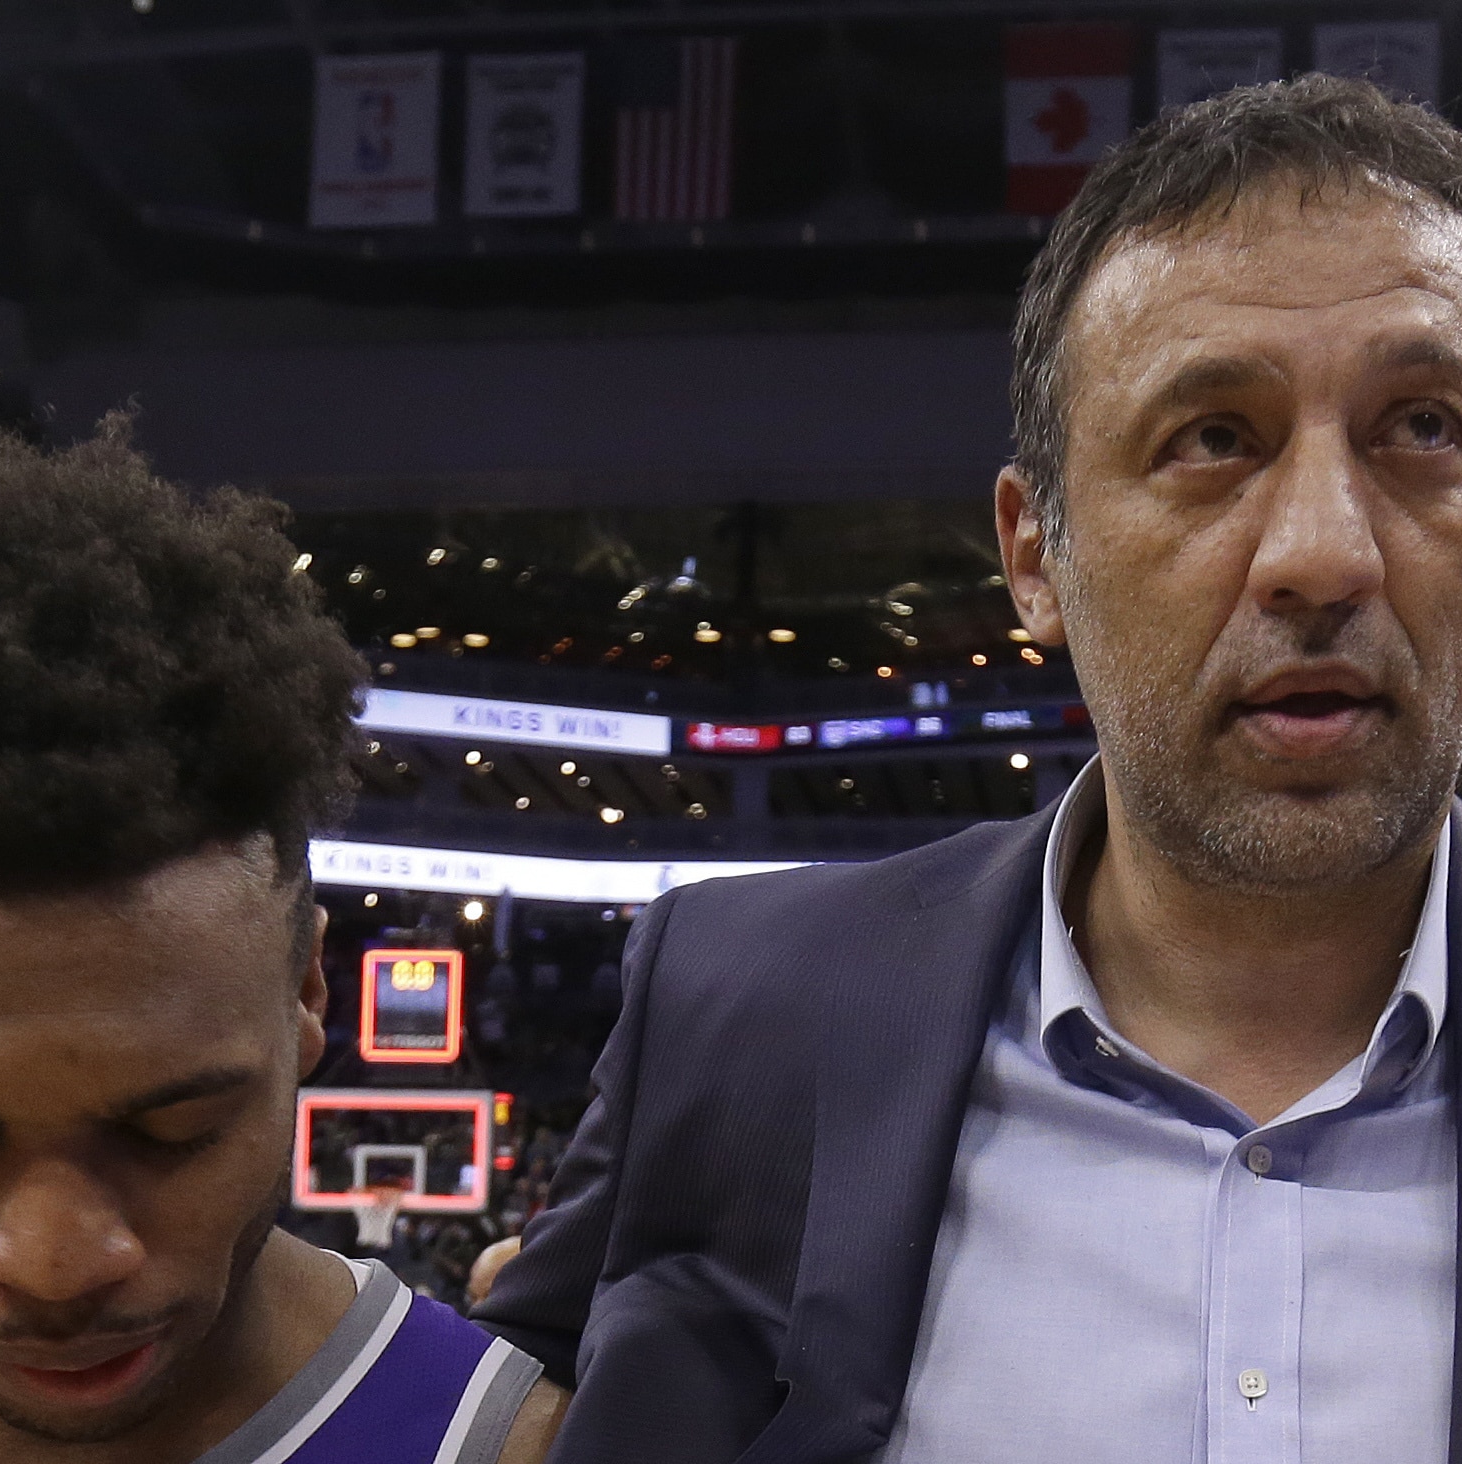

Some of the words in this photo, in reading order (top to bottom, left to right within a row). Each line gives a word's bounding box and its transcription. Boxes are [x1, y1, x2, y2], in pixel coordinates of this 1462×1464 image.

[453, 704, 543, 732] KINGS
[554, 711, 622, 739] WIN!
[323, 850, 413, 876] KINGS
